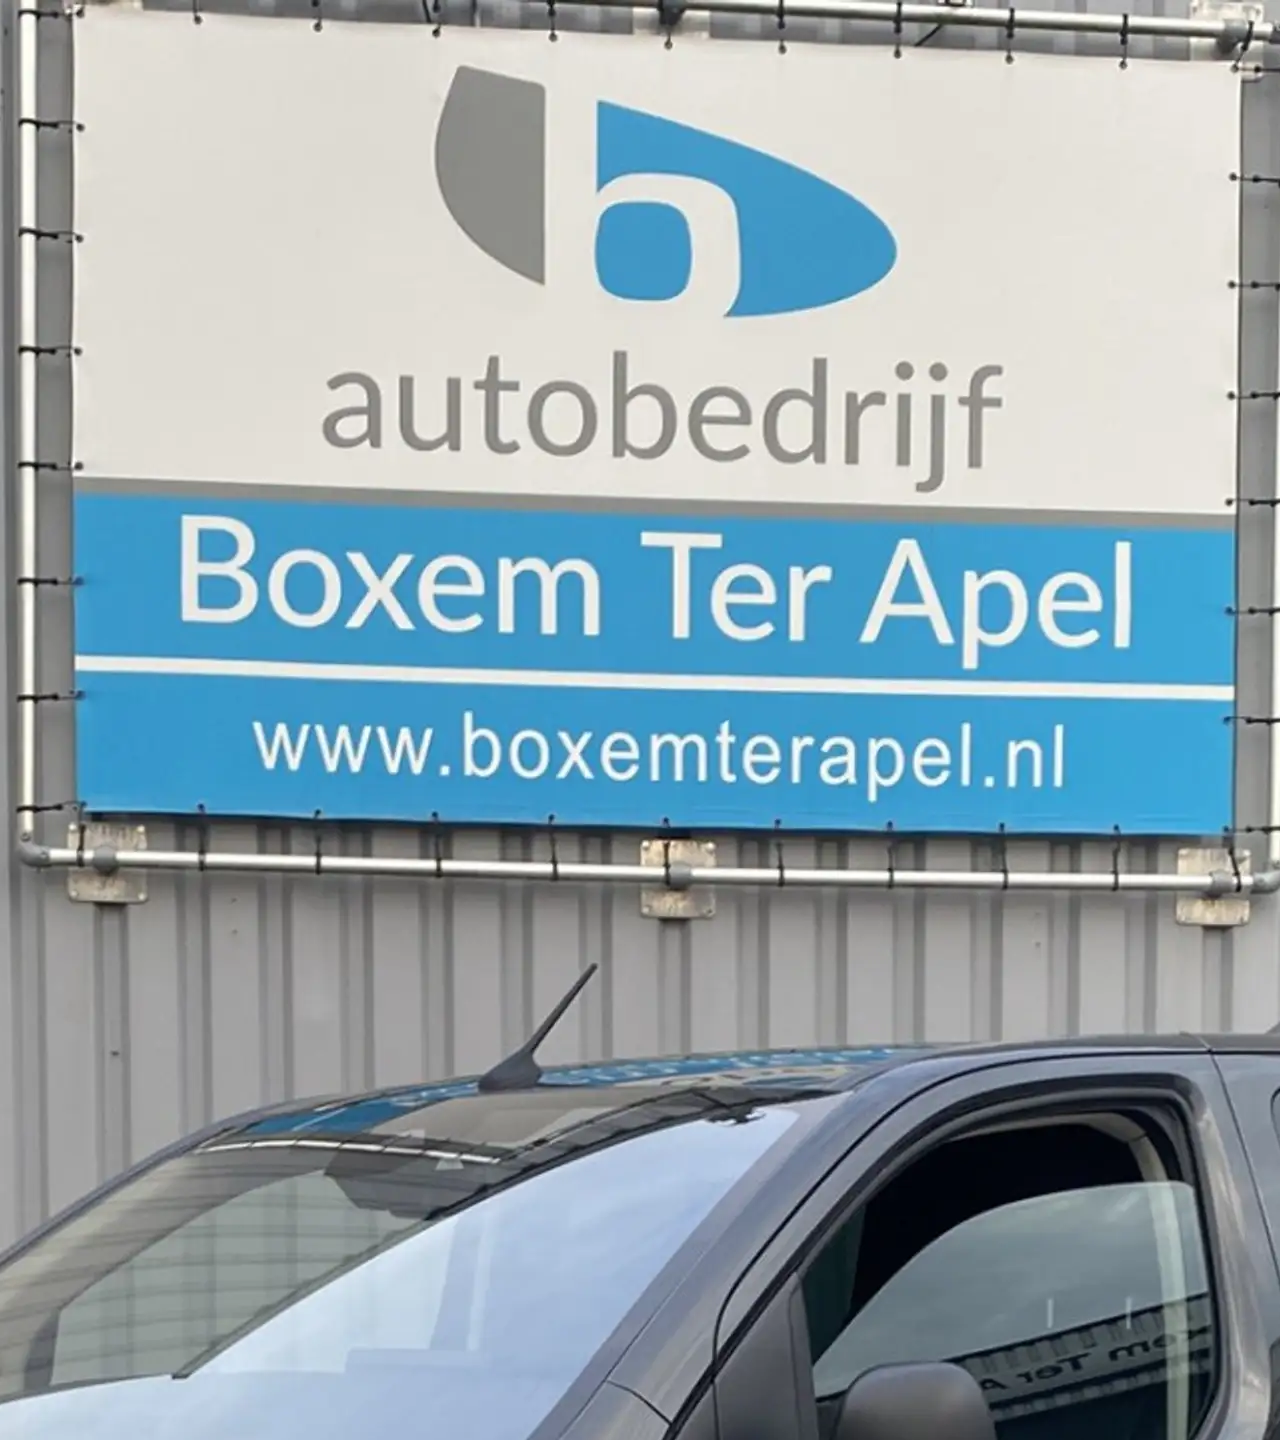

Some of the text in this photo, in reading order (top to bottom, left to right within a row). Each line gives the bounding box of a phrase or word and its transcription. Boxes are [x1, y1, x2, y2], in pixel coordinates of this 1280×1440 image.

[322, 350, 1003, 493] autobedrijf
[179, 514, 1133, 671] Boxem Ter Apel
[252, 711, 1065, 803] www.boxemterapel.nl
